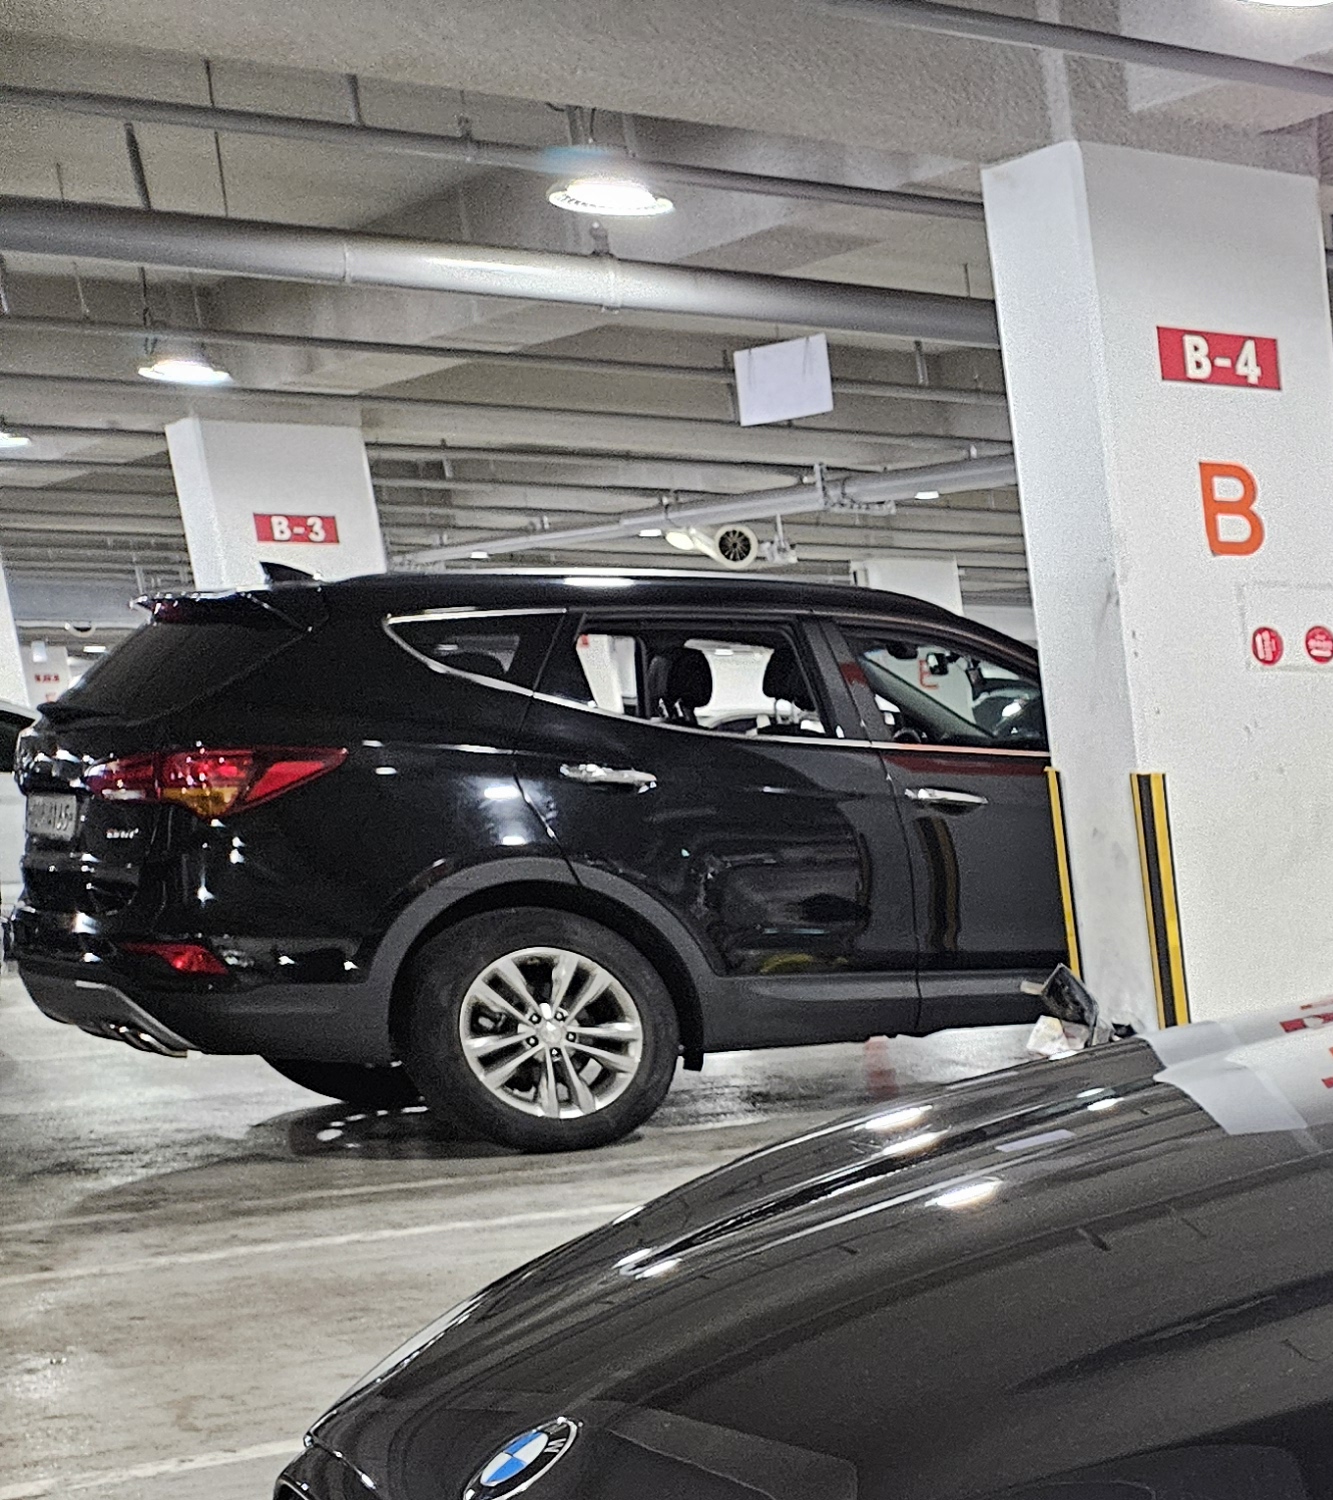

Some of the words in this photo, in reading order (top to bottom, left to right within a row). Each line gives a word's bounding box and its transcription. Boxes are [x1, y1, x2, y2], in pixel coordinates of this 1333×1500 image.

[1182, 333, 1262, 385] B-4
[270, 515, 326, 542] B-3
[1198, 461, 1265, 556] B
